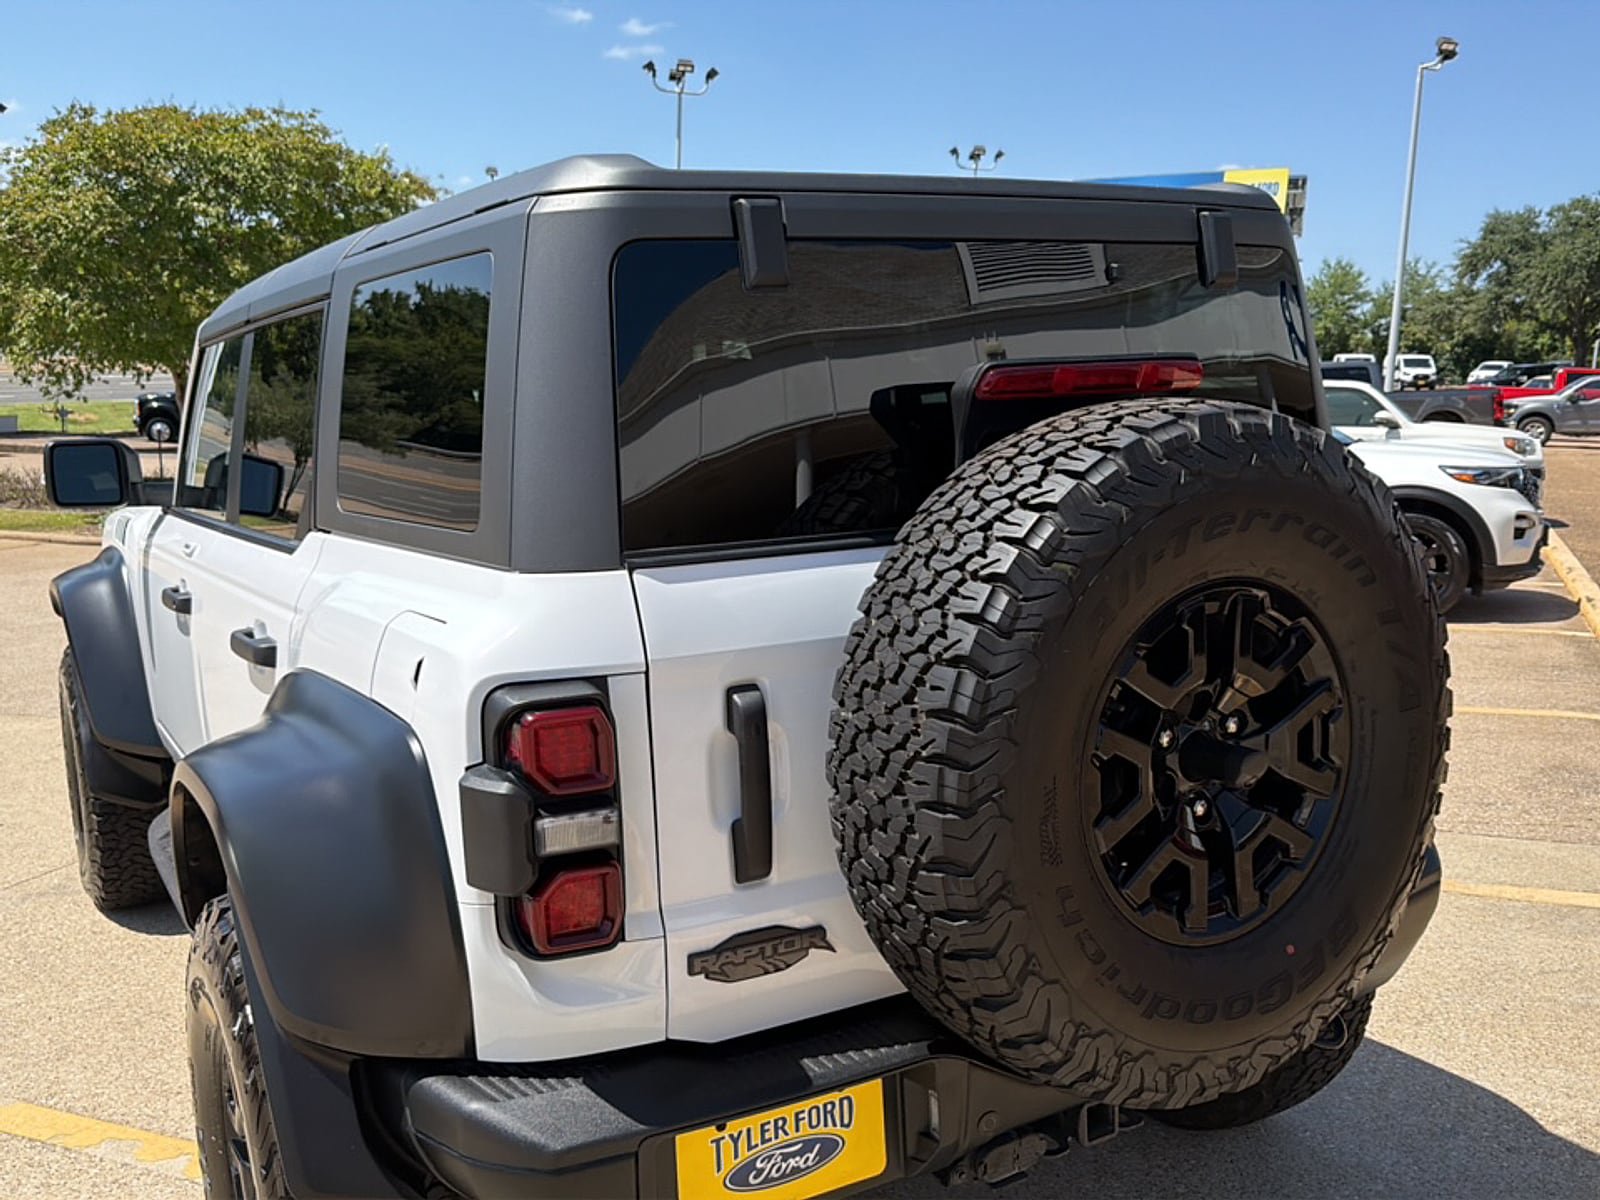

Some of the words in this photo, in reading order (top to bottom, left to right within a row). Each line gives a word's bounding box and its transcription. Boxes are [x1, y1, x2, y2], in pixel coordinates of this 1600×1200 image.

[690, 929, 837, 978] RAPTOR
[1054, 885, 1360, 1025] BFGoodrich
[710, 1115, 789, 1175] TYLER
[794, 1094, 854, 1133] FORD
[748, 1142, 822, 1185] Ford
